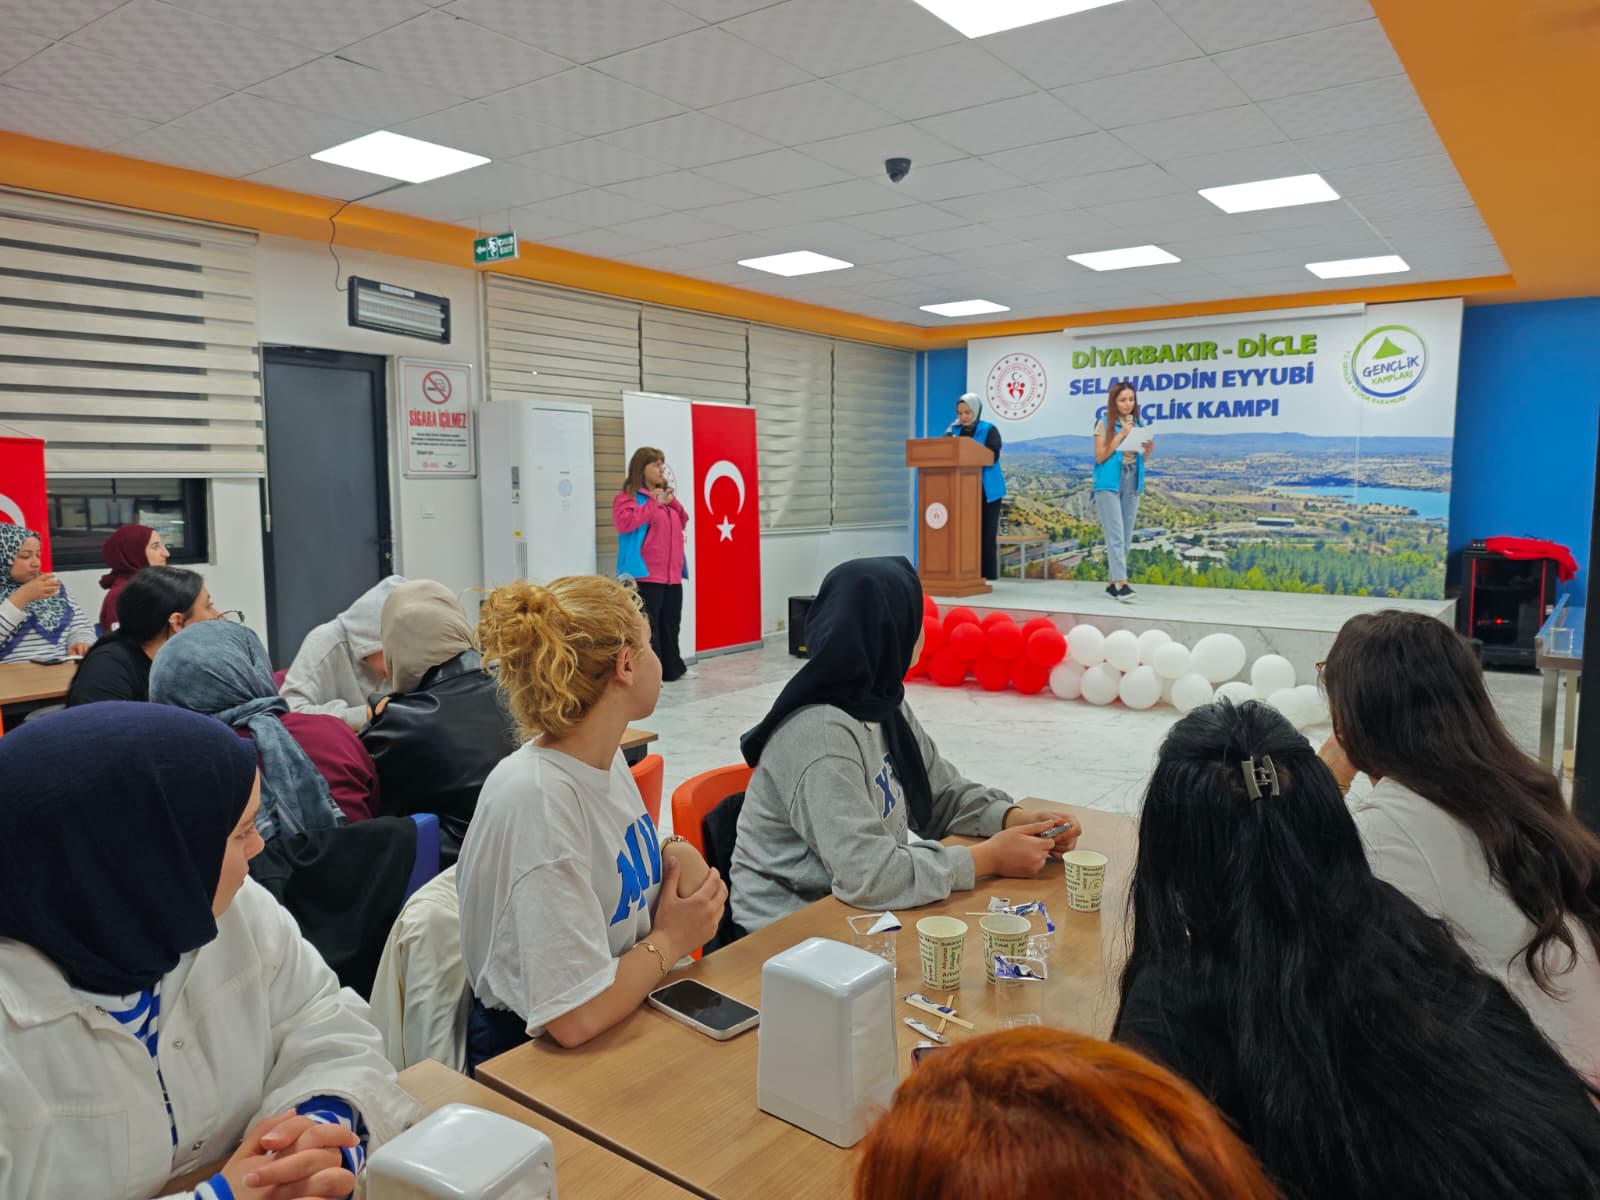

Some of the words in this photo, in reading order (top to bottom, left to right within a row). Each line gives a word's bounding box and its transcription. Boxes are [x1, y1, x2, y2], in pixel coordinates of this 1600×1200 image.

[1072, 341, 1218, 369] DİYARBAKIR
[1237, 333, 1318, 359] DİCLE
[1222, 361, 1314, 388] EYYUBİ
[1362, 355, 1420, 378] GENÇLİK
[1371, 370, 1414, 385] KAMPLARI
[1197, 398, 1280, 419] KAMPI
